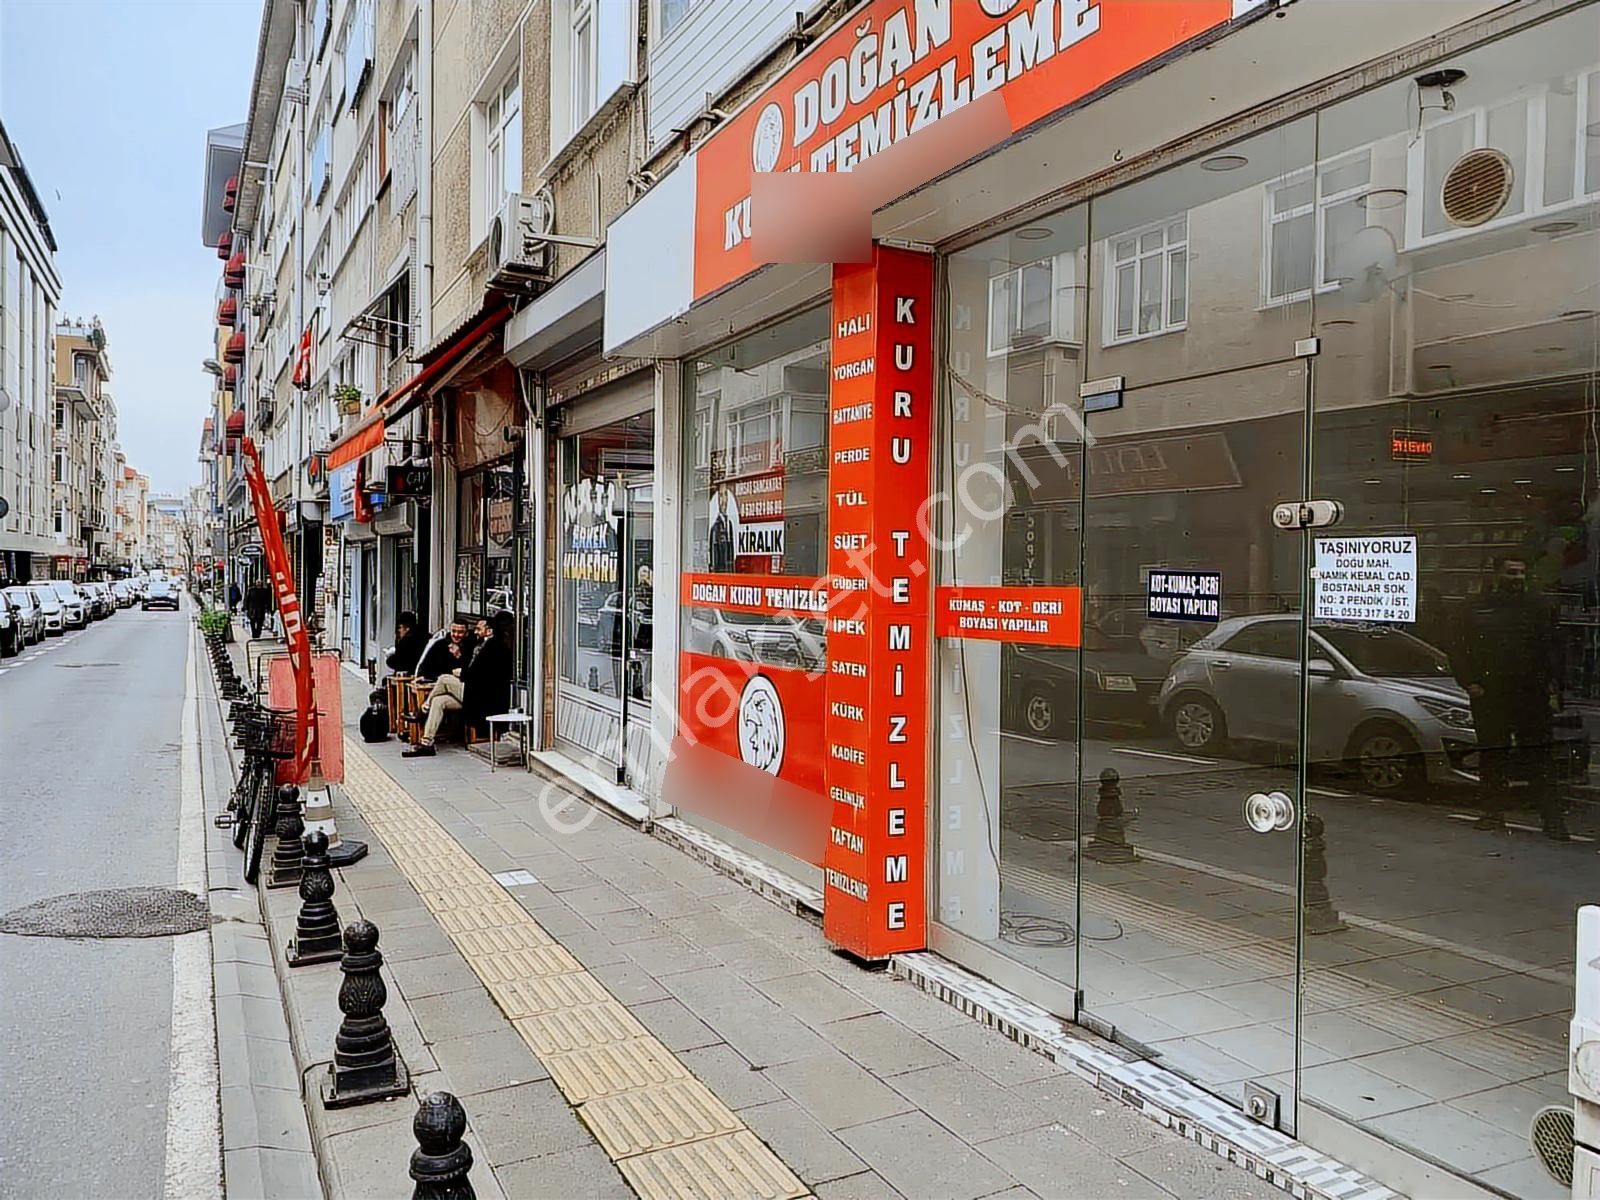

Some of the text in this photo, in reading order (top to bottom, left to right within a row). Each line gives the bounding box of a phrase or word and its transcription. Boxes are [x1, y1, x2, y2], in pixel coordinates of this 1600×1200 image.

[793, 0, 952, 148] DOĞAN
[810, 0, 1101, 172] TEMİZLEME
[838, 313, 871, 338] HALI
[833, 357, 875, 381] YORGAN
[834, 448, 870, 465] PERDE
[836, 490, 867, 506] TÜL
[738, 525, 783, 553] KİRALIK
[834, 531, 868, 550] SÜET
[1319, 541, 1412, 557] TAŞINIYORUZ
[1366, 559, 1393, 569] MAH.
[1350, 571, 1385, 581] KEMAL
[1387, 572, 1413, 581] CAD.
[692, 579, 828, 612] DOĞAN KURU TEMİZLE
[1322, 583, 1408, 594] BOSTANLAR SOK.
[949, 599, 985, 614] KUMAŞ
[998, 600, 1022, 613] KOT
[1032, 598, 1062, 615] DERİ
[1150, 597, 1218, 616] BOYASI YAPILIR
[1320, 595, 1337, 604] NO:
[1339, 596, 1345, 604] 2
[1347, 595, 1384, 606] PENDİK
[1391, 595, 1410, 607] İST.
[885, 297, 915, 929] KURU TEMİZLEME
[1365, 609, 1380, 618] 317
[1398, 610, 1410, 619] 20
[832, 615, 866, 635] İPEK
[959, 616, 1049, 633] BOYASI YAPILIR
[831, 660, 867, 678] SATEN
[831, 701, 864, 722] KÜRK
[831, 744, 866, 765] KADİFE
[831, 826, 864, 855] TAFTAN
